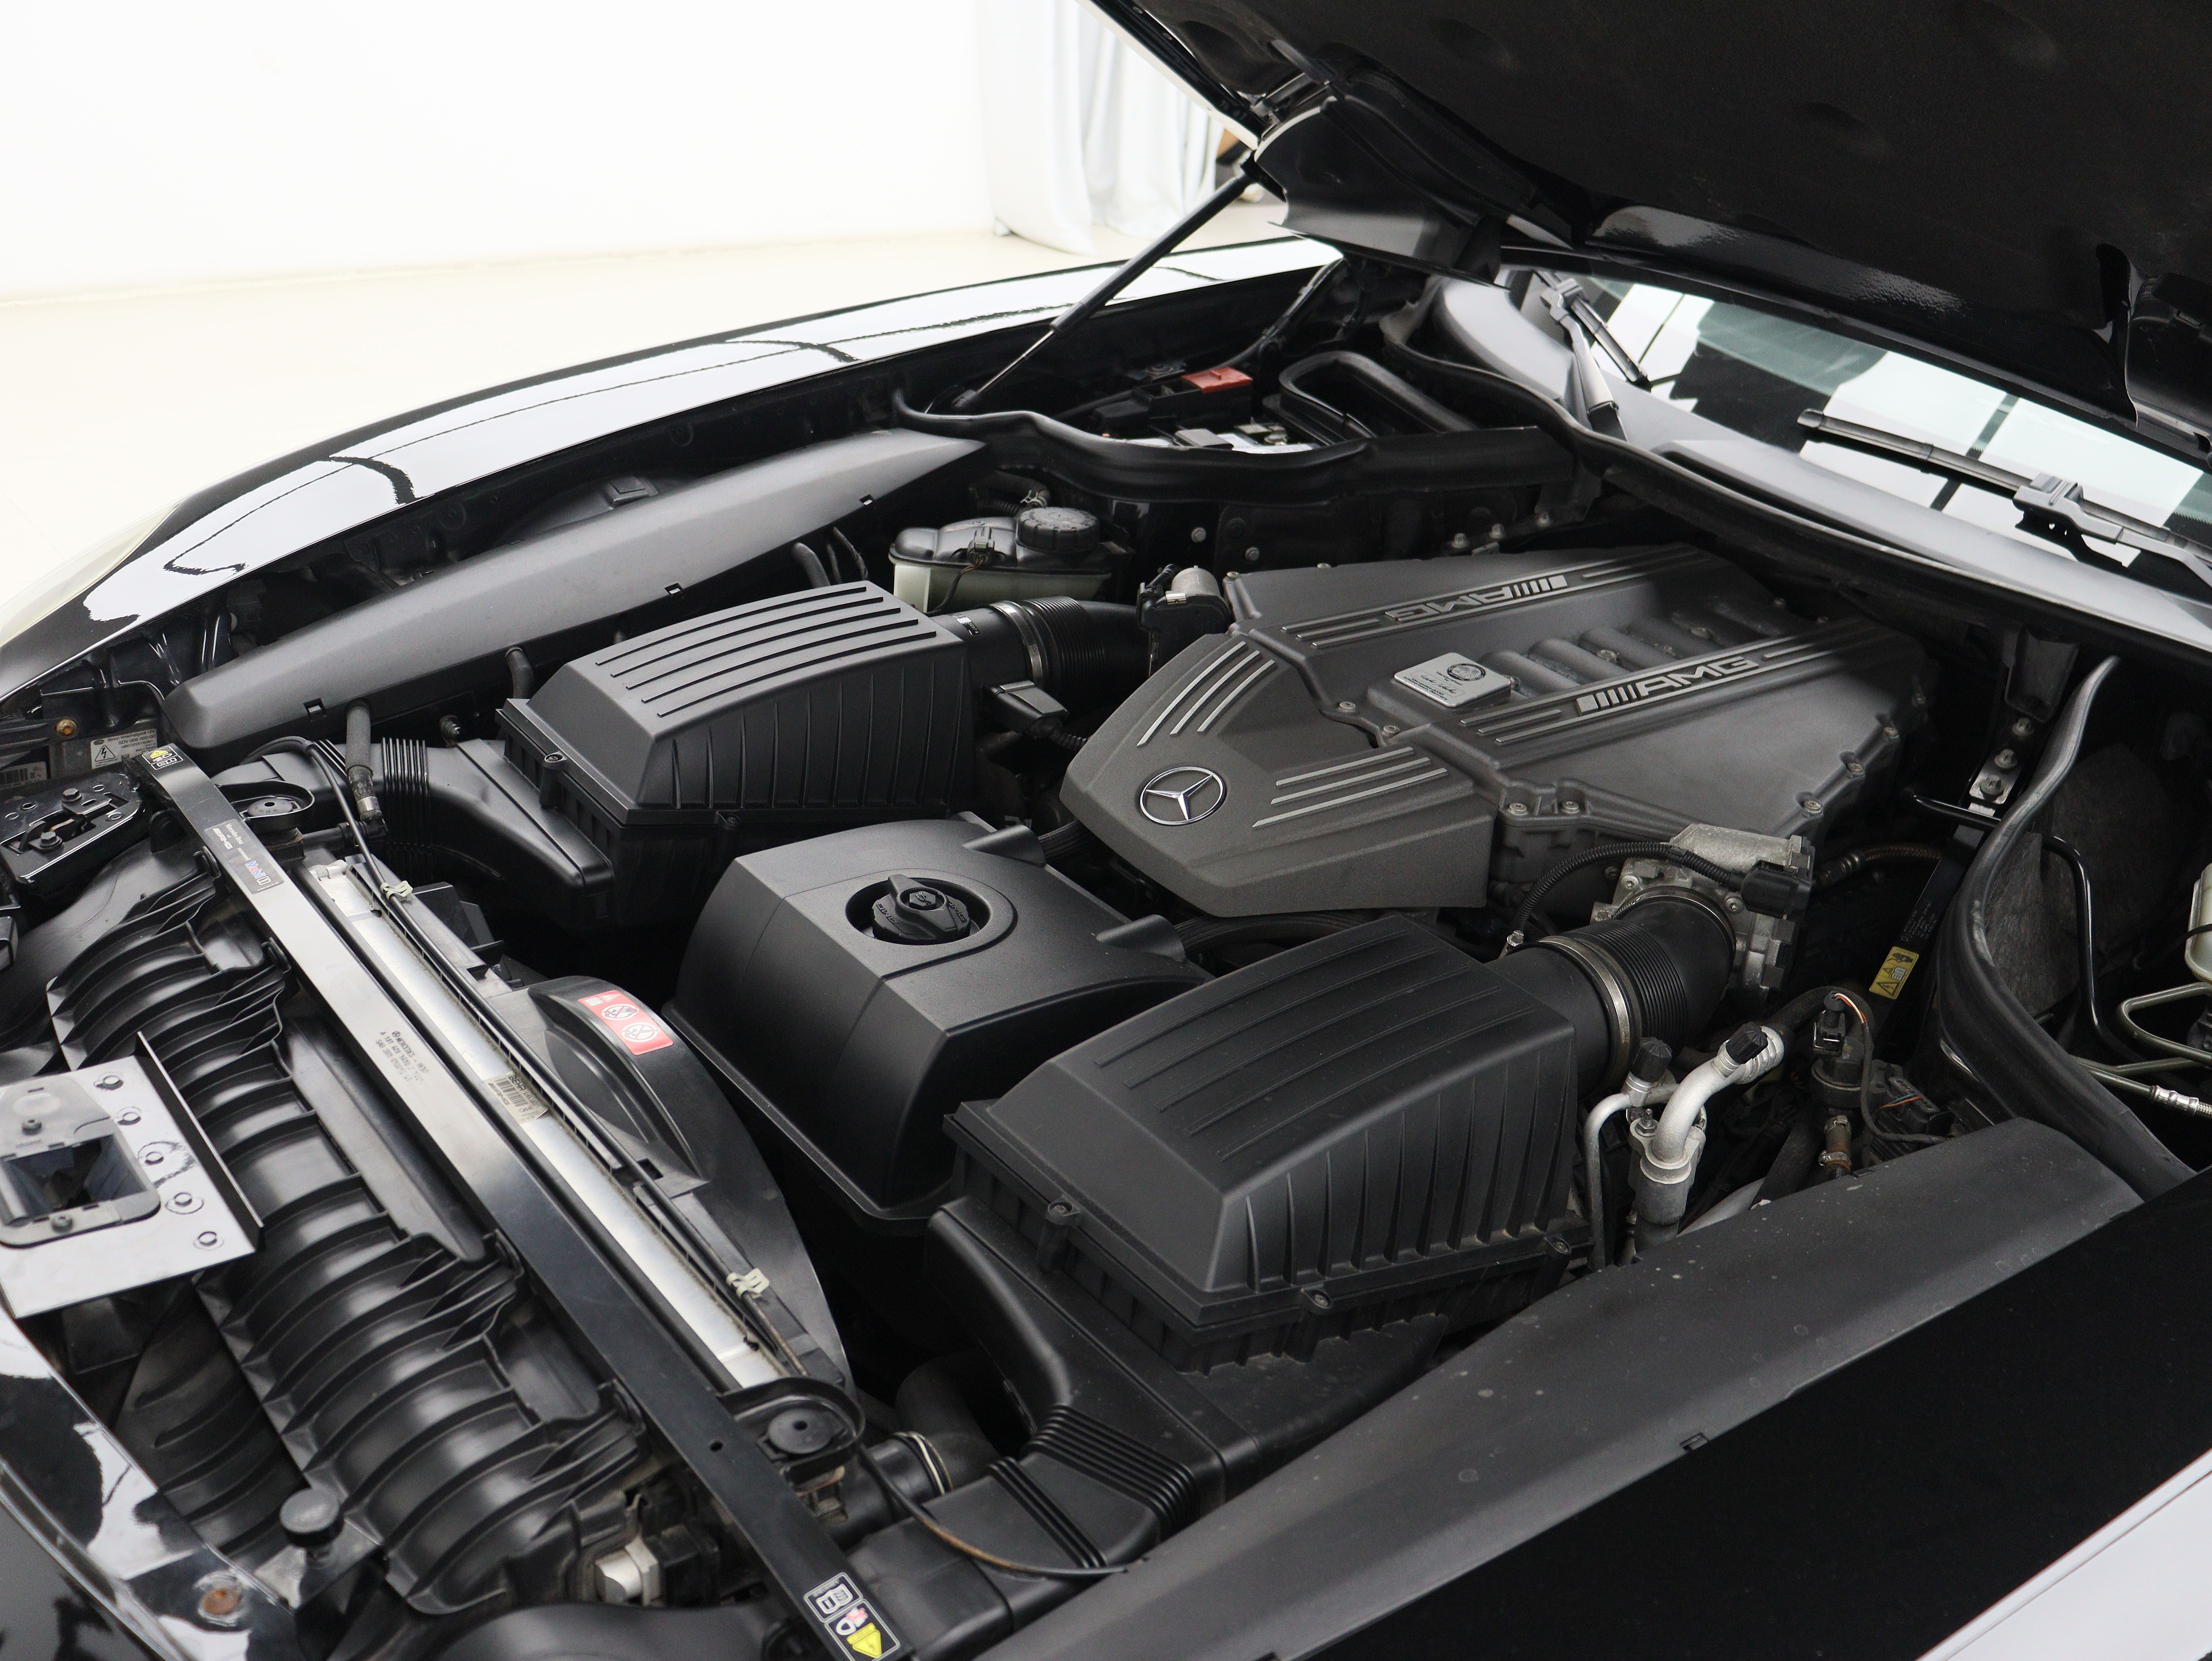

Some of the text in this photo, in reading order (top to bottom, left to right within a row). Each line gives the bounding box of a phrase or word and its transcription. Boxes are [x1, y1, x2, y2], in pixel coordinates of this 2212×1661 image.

[1385, 586, 1513, 621] AMG
[1635, 656, 1759, 697] AMG
[218, 834, 233, 850] AMG
[245, 860, 267, 880] Mobil
